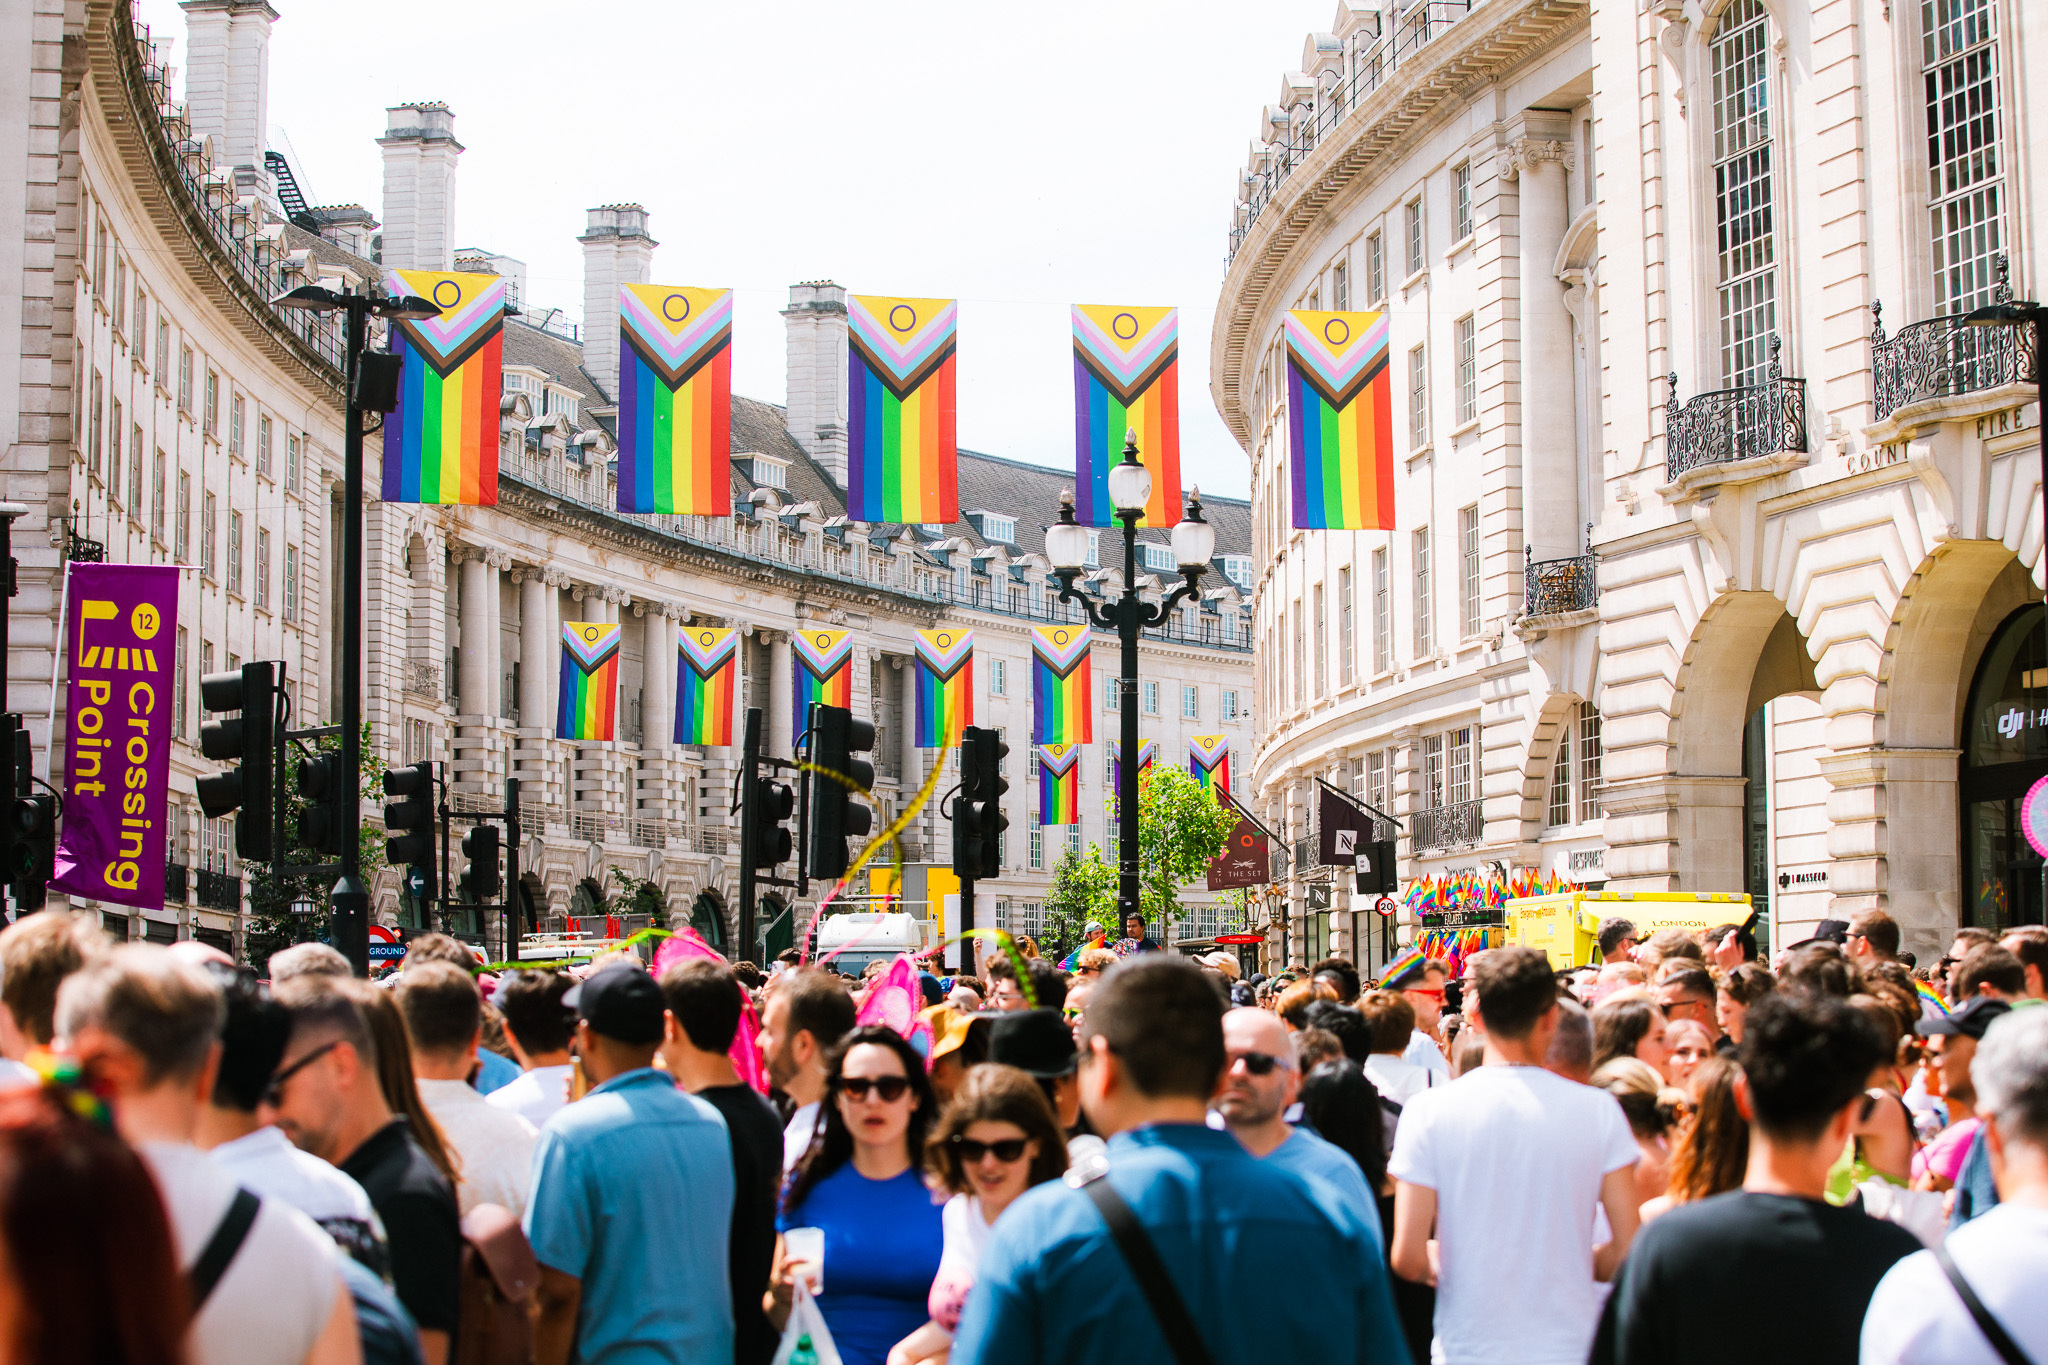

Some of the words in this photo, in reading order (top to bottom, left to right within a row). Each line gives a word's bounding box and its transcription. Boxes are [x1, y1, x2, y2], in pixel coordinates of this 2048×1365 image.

[1847, 440, 1910, 475] COUNT
[1976, 407, 2023, 439] FIRE
[138, 613, 153, 630] 12
[74, 679, 112, 797] Point
[103, 681, 155, 890] Crossing
[1567, 848, 1606, 876] NESPRES
[1228, 870, 1244, 878] THE
[1795, 871, 1828, 883] HASSELB
[1380, 902, 1393, 912] 20
[369, 947, 406, 955] GROUND
